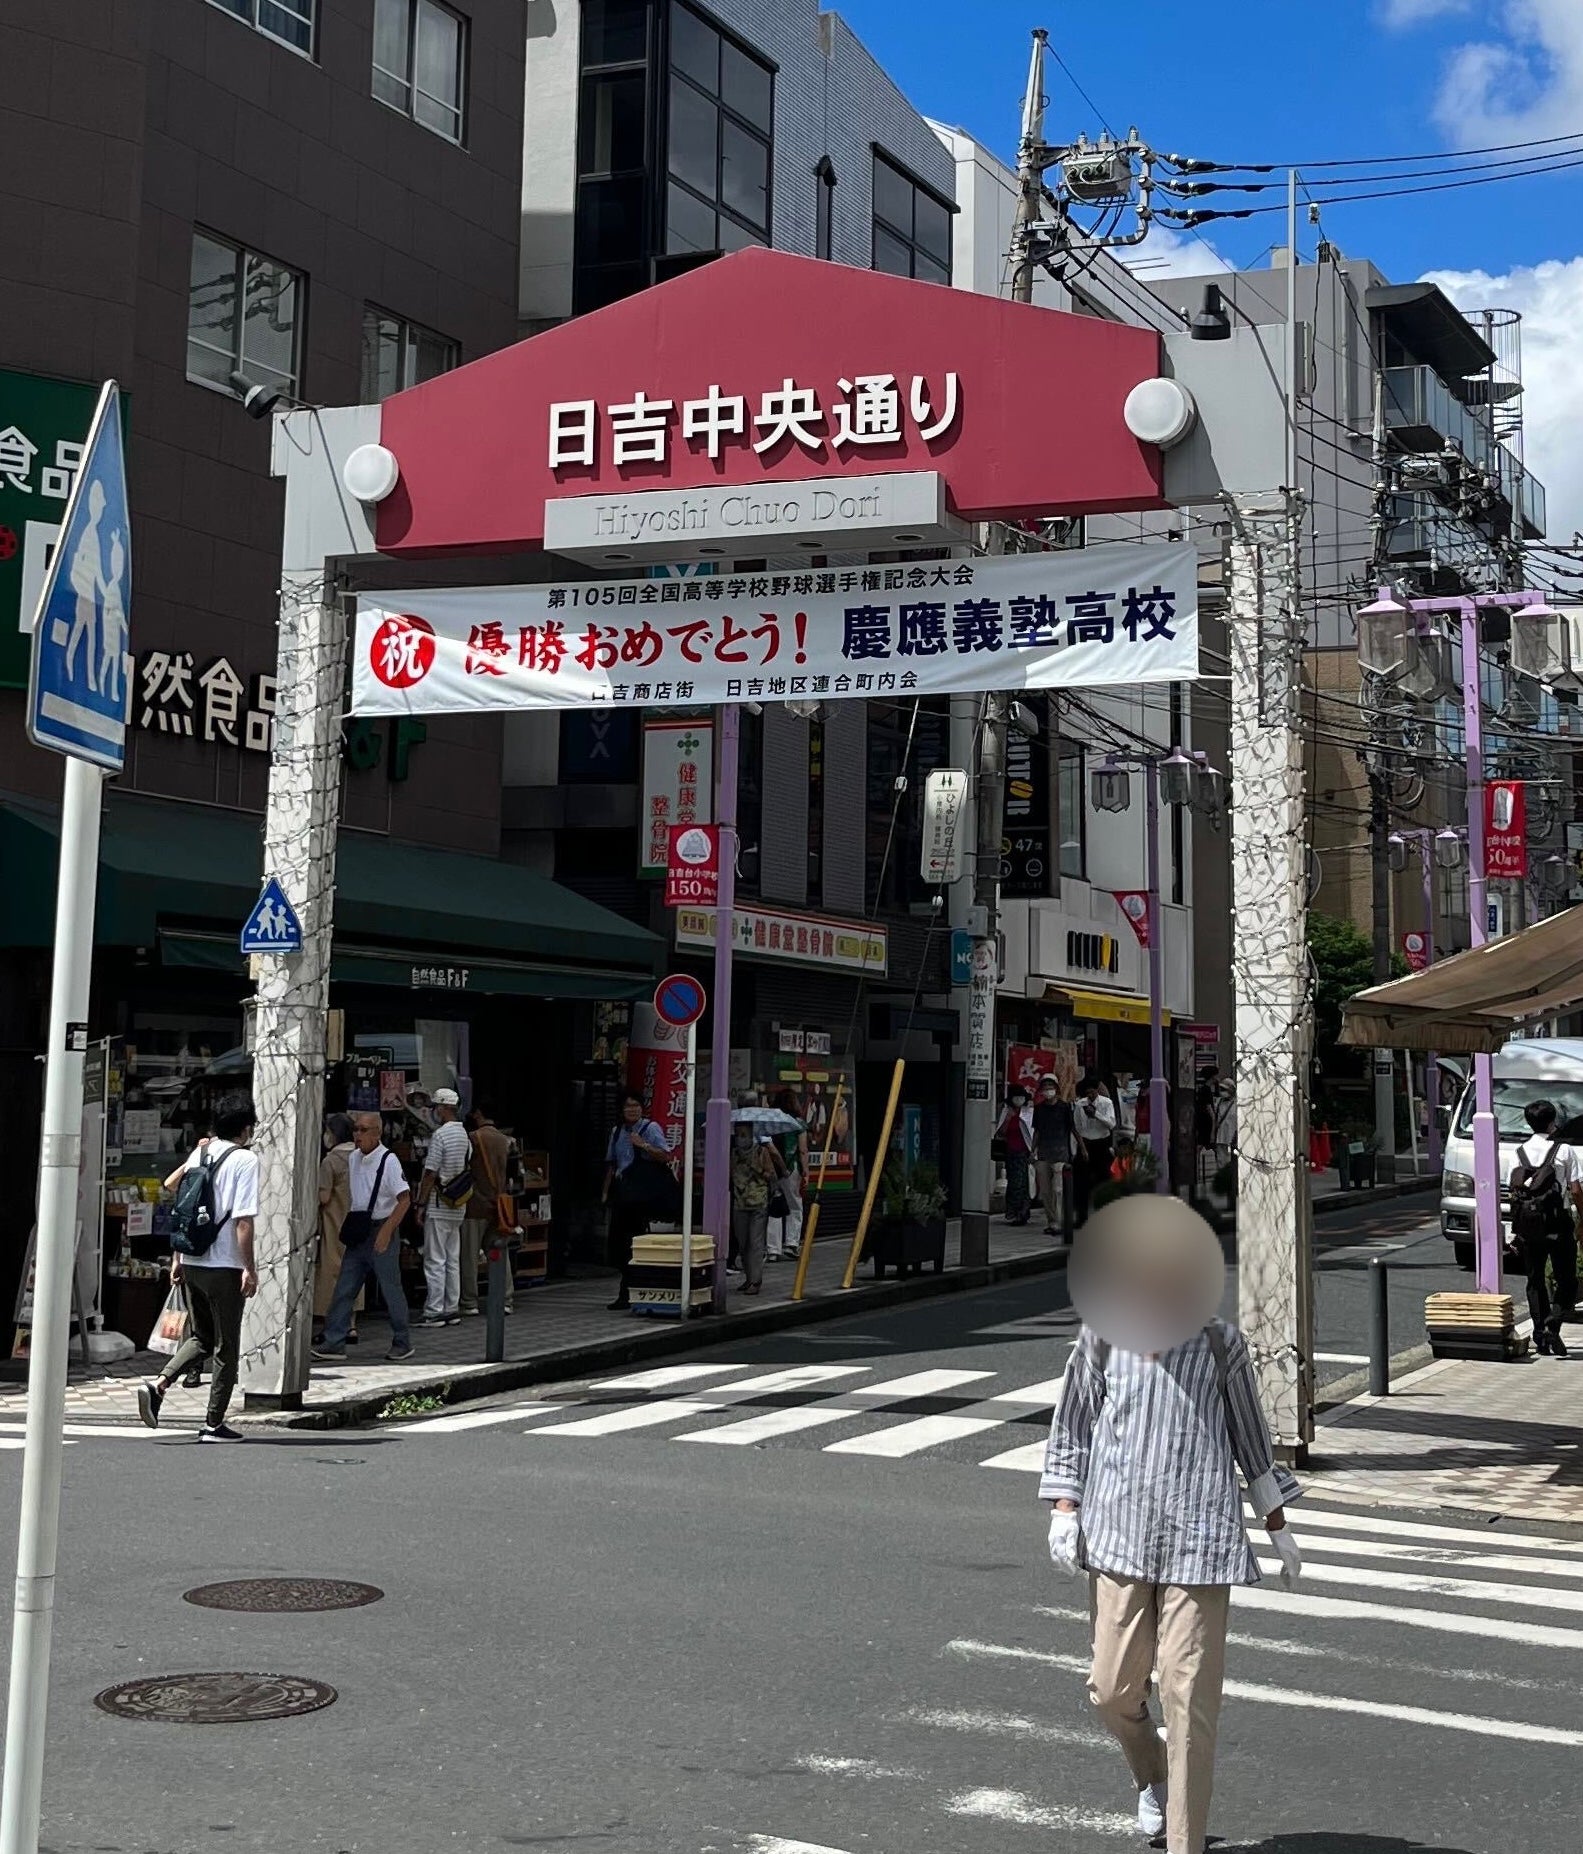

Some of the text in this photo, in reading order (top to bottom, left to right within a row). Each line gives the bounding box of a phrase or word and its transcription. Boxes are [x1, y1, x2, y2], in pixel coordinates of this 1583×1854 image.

[548, 372, 959, 469] 日吉中央通り
[593, 486, 884, 540] Hiyoshi Chuo Dori
[547, 564, 974, 609] 第105回全国高等学校野球選手権記念大会
[380, 585, 1178, 681] 祝 優勝おめでとう！ 慶應義塾高校
[122, 650, 276, 752] 然食品
[726, 671, 918, 696] 日吉地区連合町内会
[754, 919, 834, 957] 健康堂整骨院
